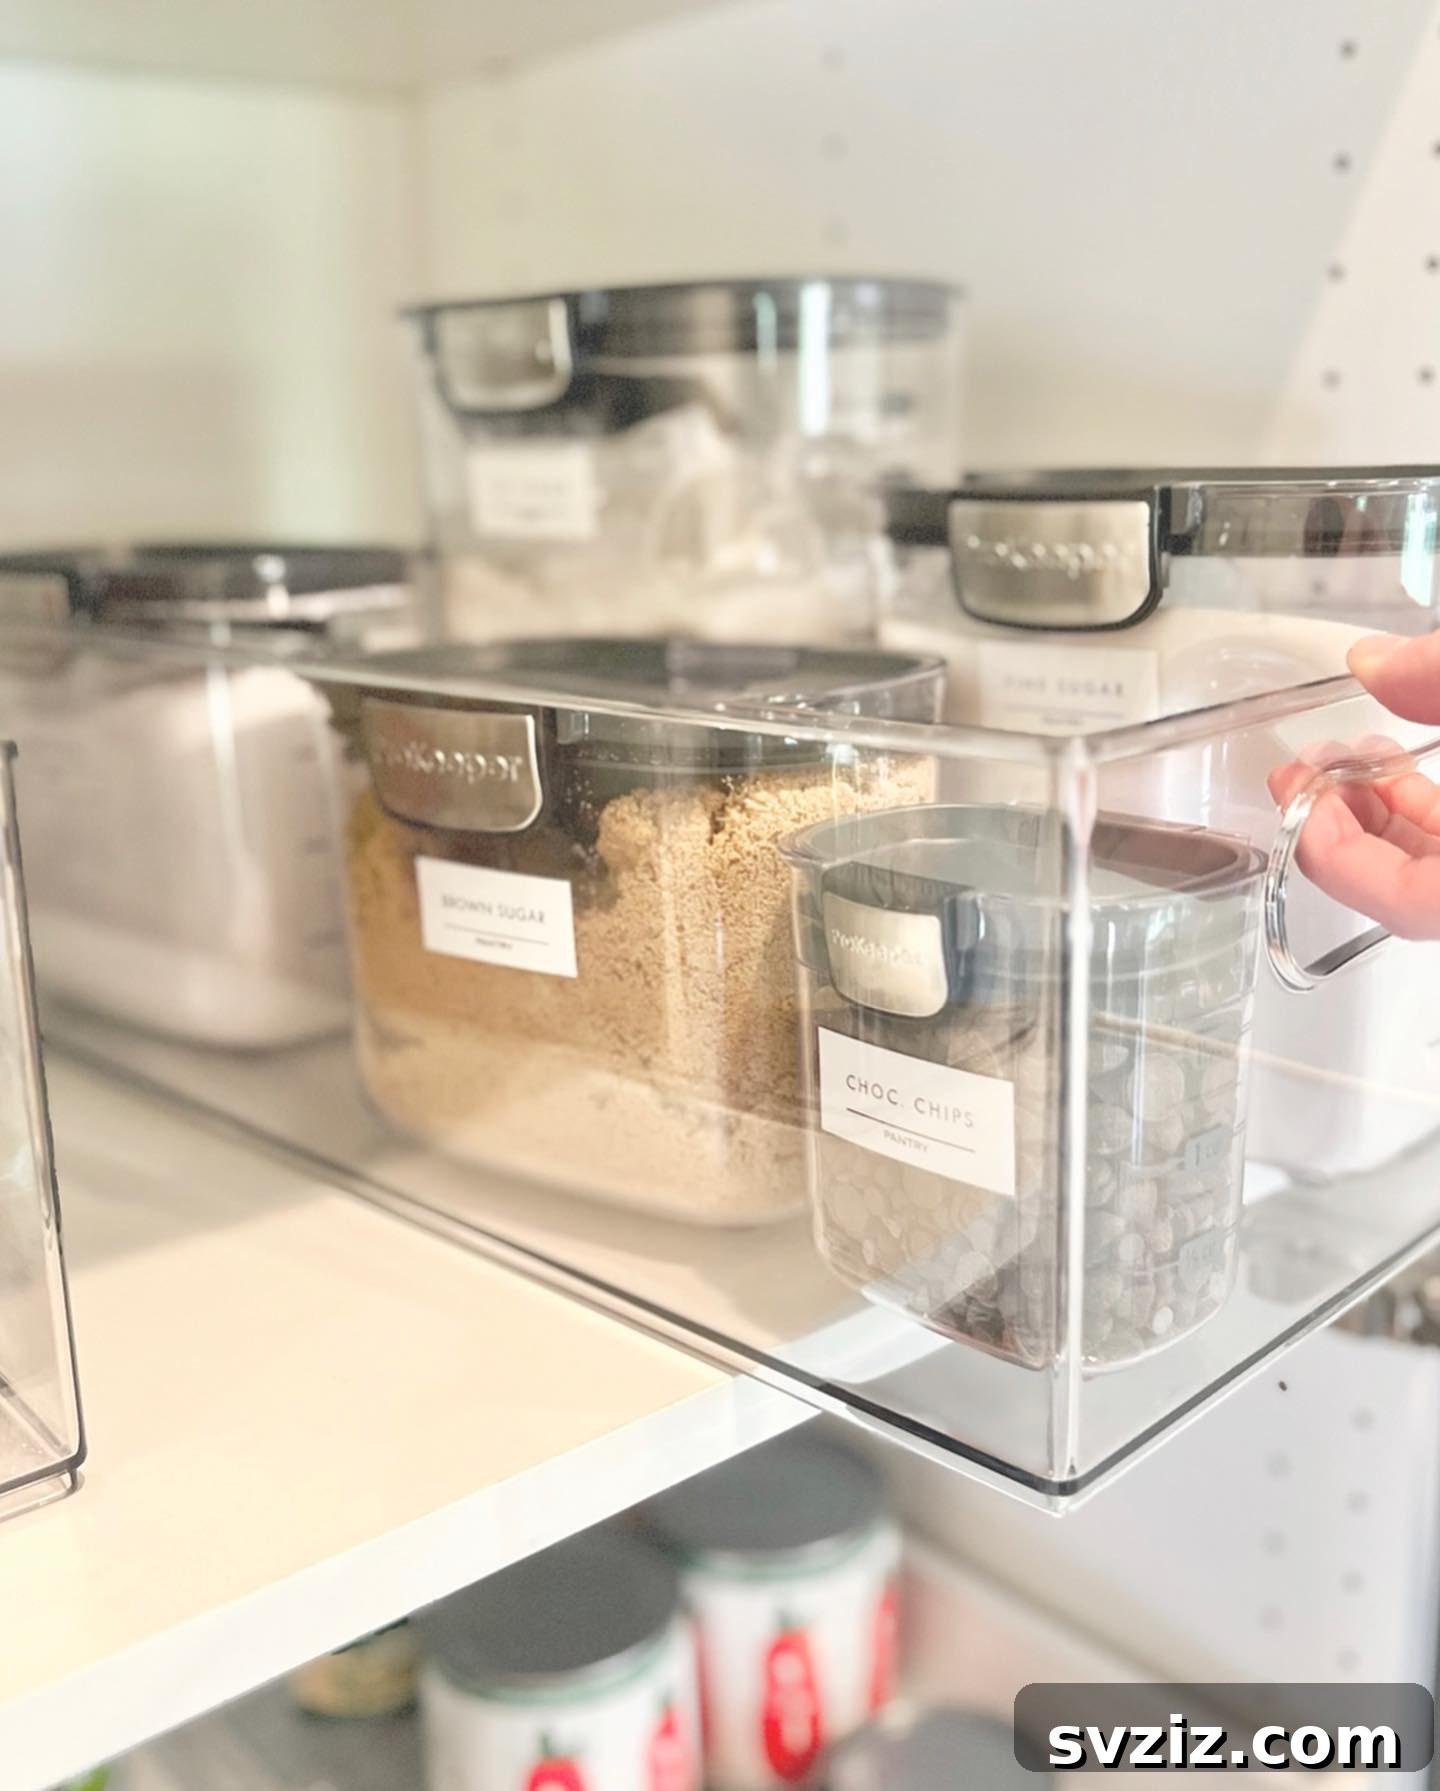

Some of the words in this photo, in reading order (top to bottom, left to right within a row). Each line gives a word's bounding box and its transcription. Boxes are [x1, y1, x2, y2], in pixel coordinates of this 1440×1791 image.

[497, 902, 546, 924] SUGAR
[914, 1097, 974, 1128] CHIPS
[883, 1129, 928, 1152] PANTRY
